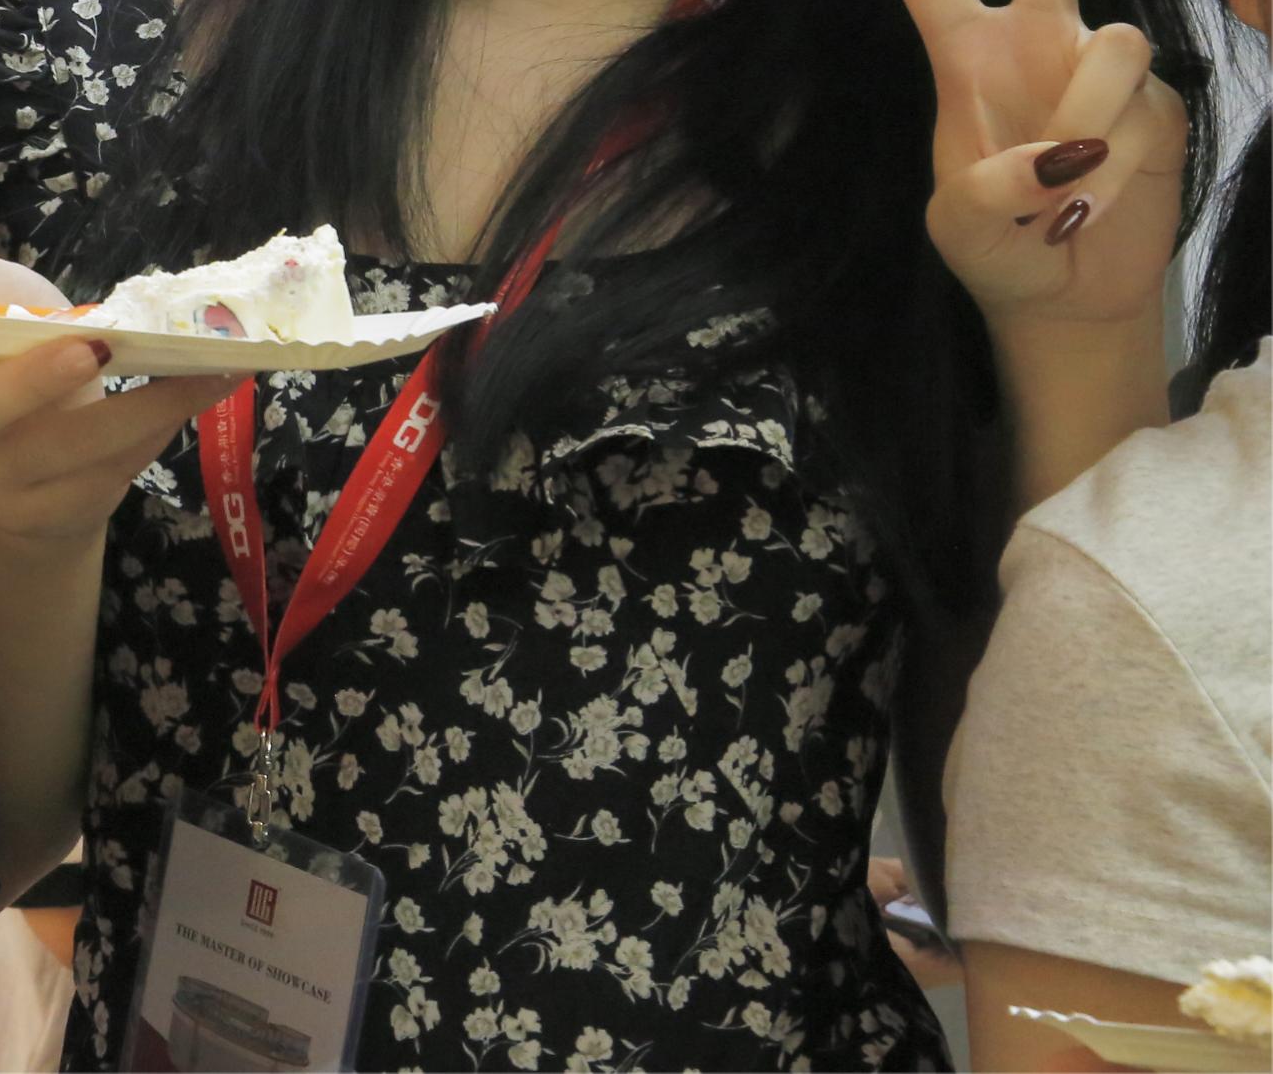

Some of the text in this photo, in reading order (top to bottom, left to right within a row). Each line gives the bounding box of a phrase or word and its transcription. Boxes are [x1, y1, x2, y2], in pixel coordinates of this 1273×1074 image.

[393, 391, 442, 454] DG
[222, 491, 251, 559] DG
[175, 923, 333, 1005] THE MASTER OF SHOWCASE
